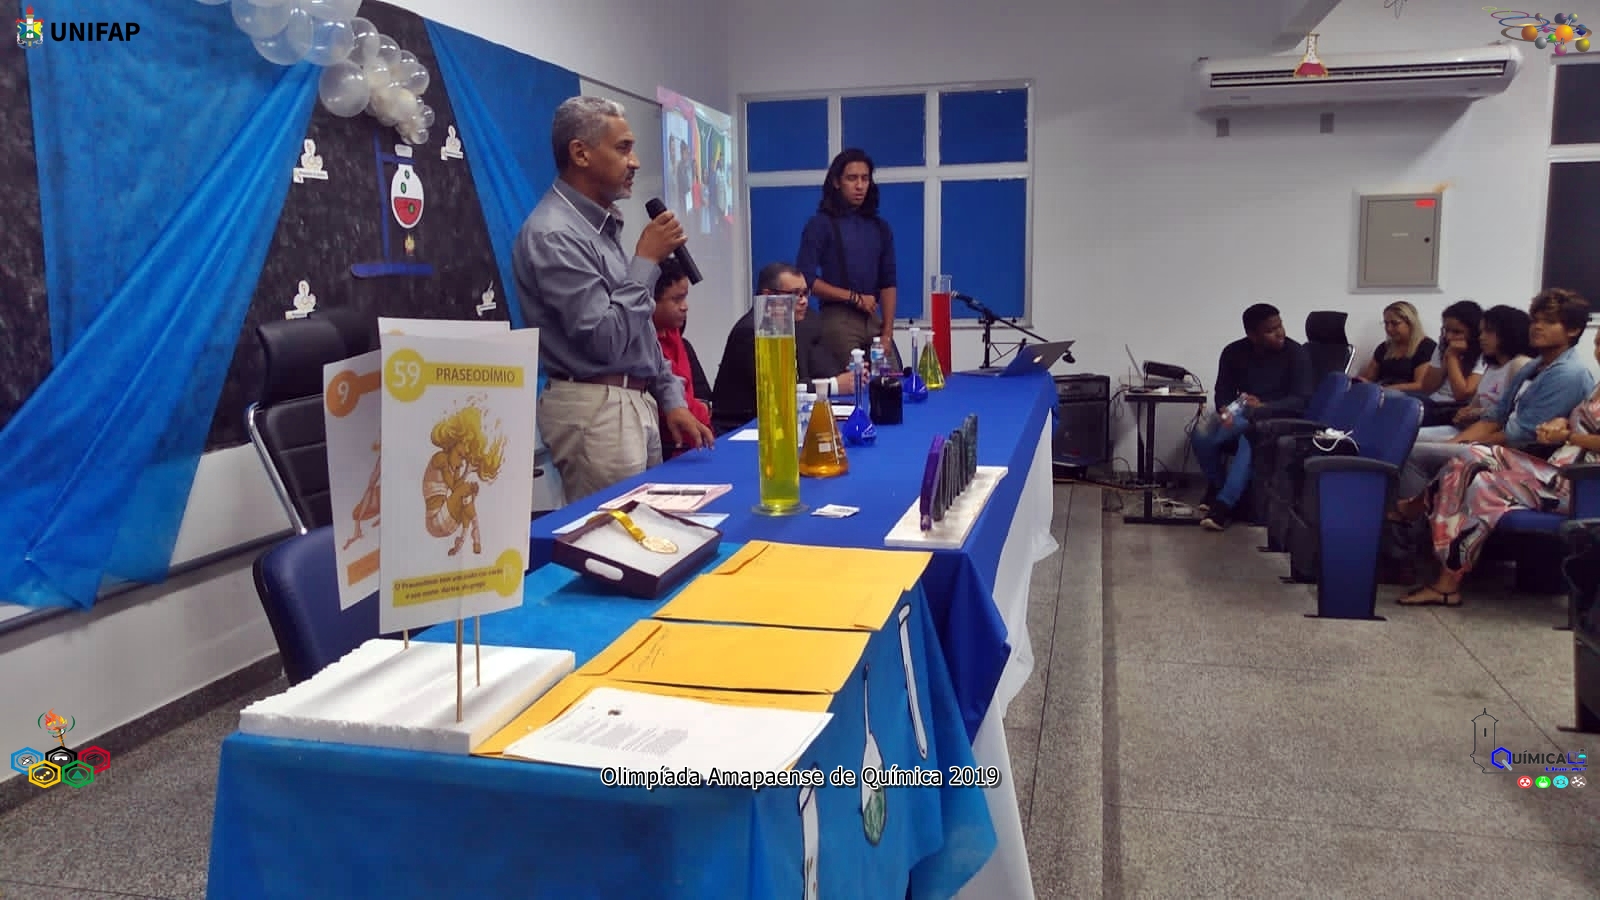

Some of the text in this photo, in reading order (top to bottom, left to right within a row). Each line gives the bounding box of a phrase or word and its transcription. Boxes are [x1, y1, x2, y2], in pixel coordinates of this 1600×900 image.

[393, 361, 421, 388] 59
[436, 367, 515, 384] PRASEODÍMIO
[337, 381, 350, 405] 9
